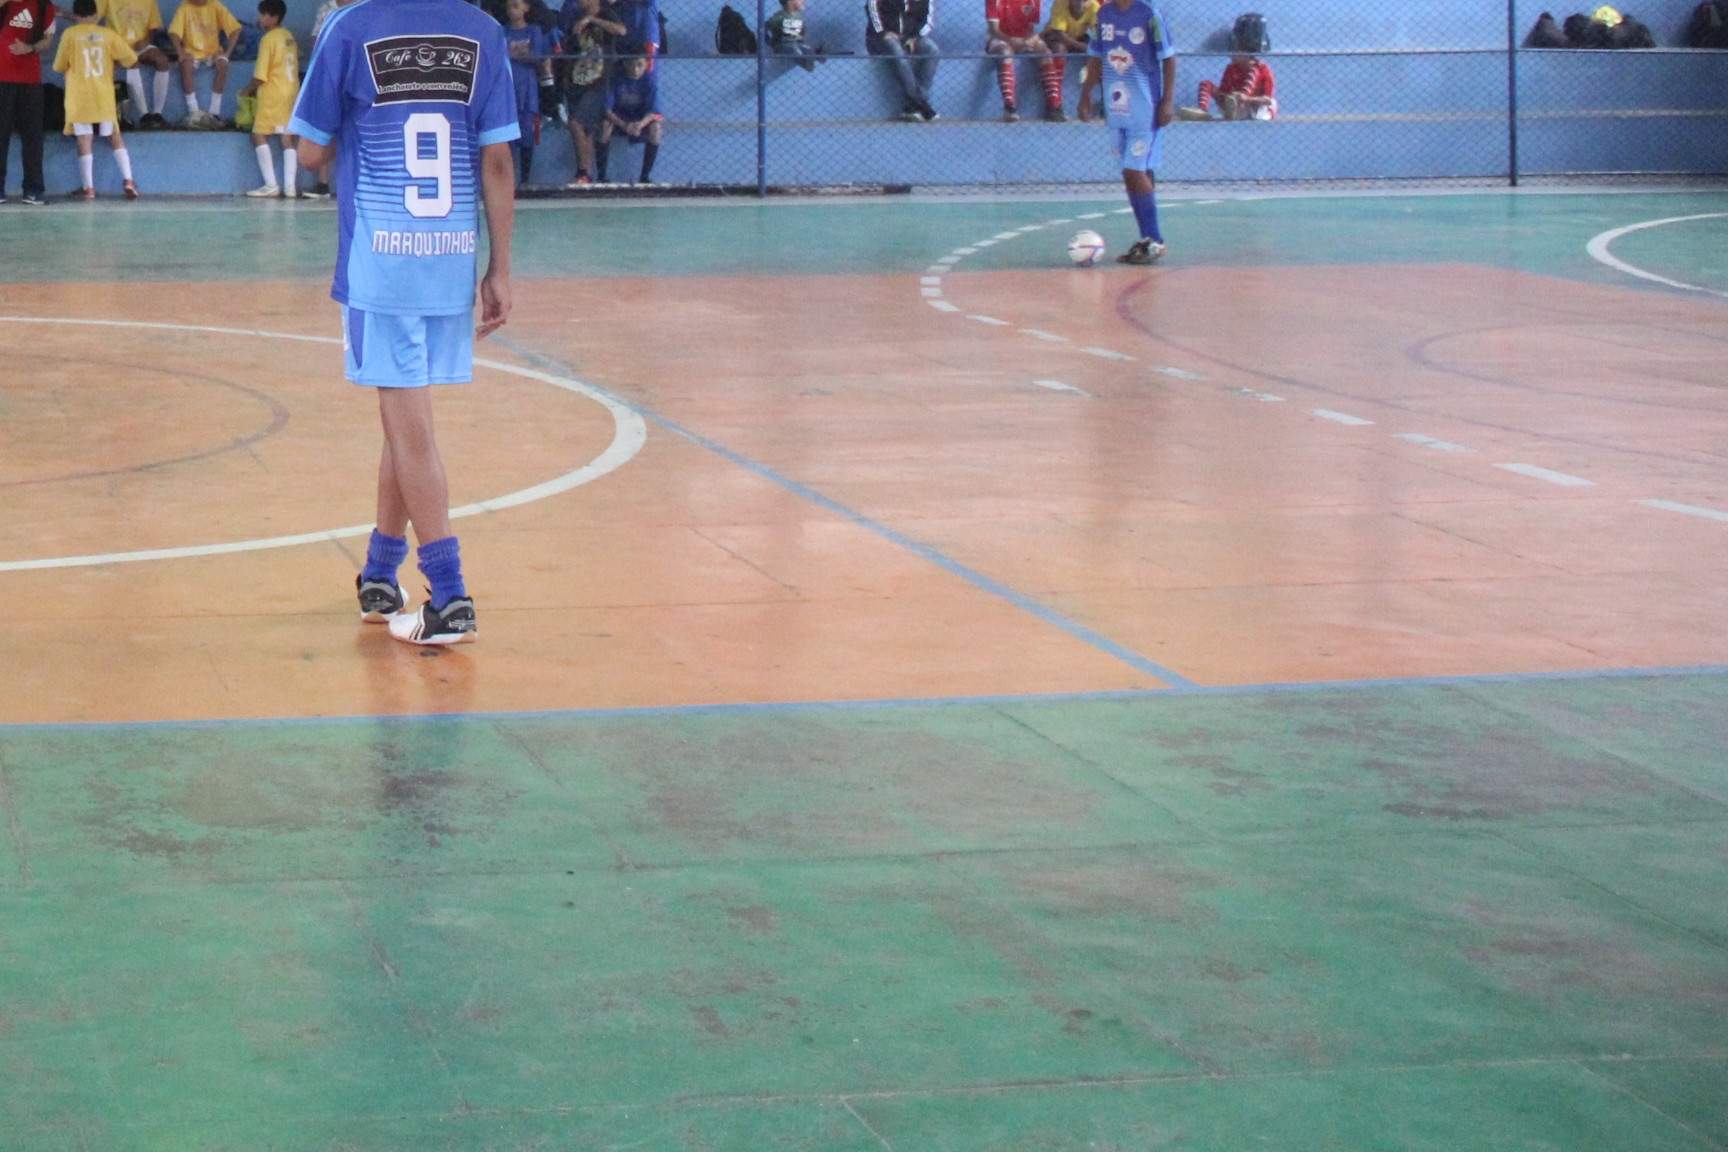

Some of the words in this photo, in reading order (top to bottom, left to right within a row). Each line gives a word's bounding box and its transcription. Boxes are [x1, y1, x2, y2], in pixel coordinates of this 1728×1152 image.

[83, 46, 104, 80] 13
[441, 50, 471, 67] 262
[404, 113, 452, 218] 9
[373, 230, 475, 256] MARQUINHOS
